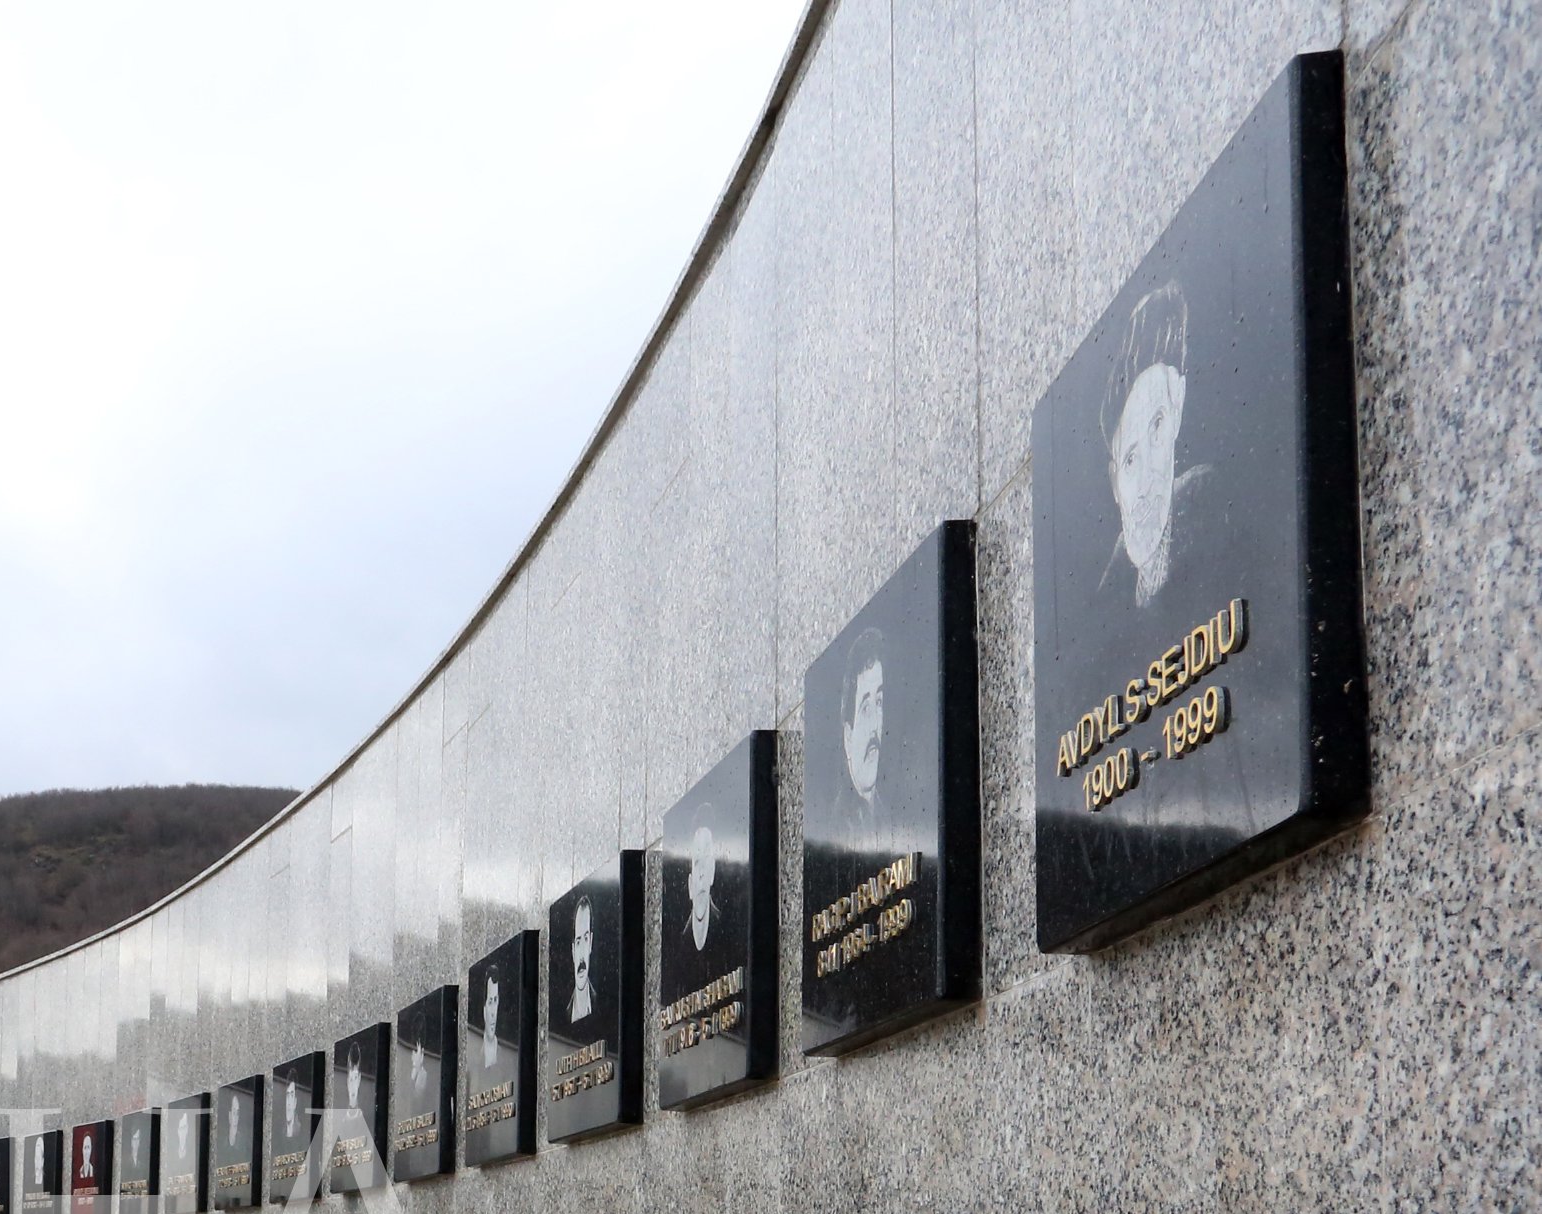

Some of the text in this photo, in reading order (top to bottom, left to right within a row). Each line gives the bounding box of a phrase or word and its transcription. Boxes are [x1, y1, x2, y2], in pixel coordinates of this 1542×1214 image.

[1057, 598, 1243, 777] AVDYL S SEJDIU
[1083, 747, 1134, 812] 1900
[1163, 686, 1224, 759] 1999
